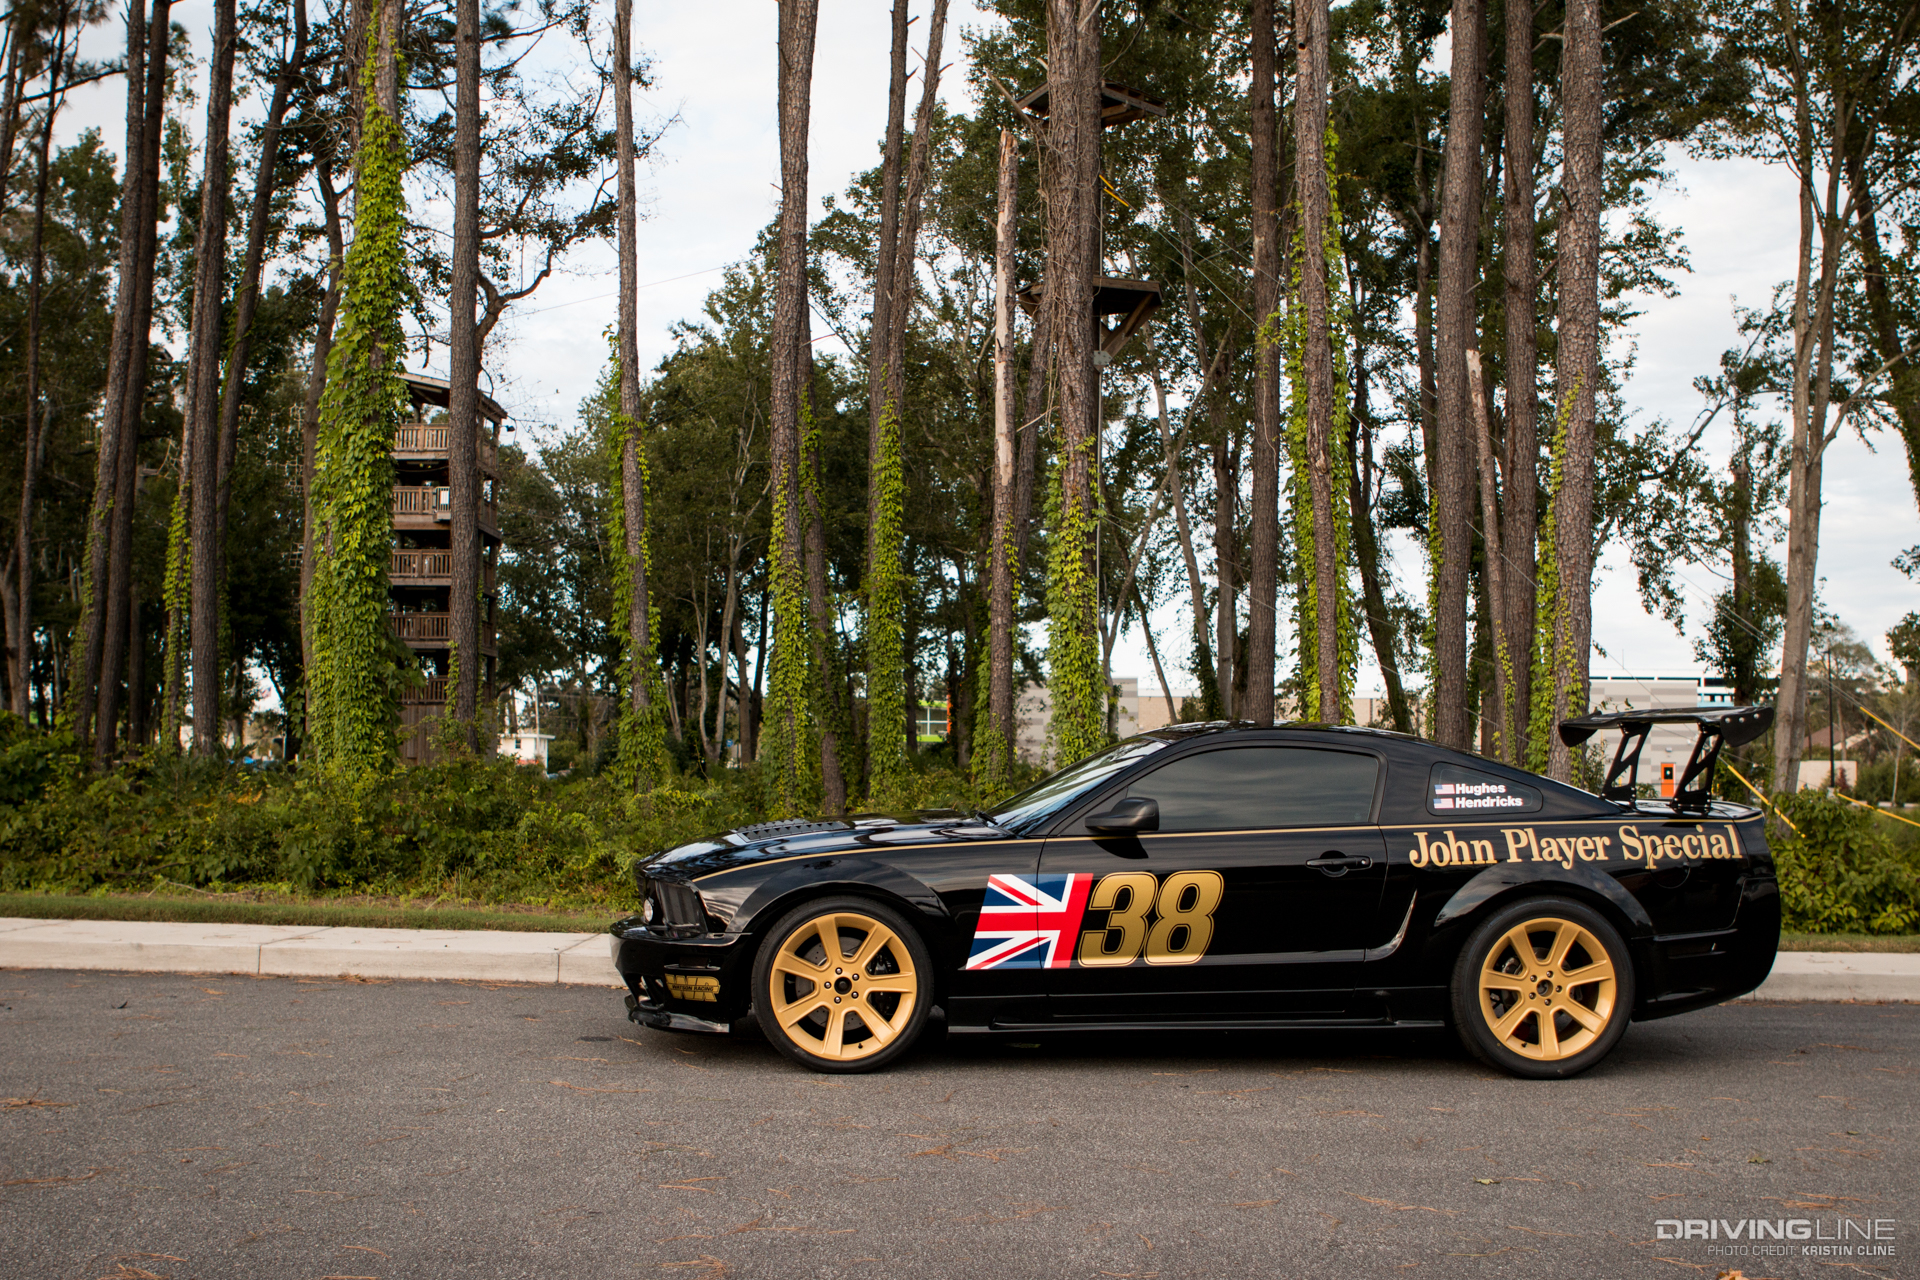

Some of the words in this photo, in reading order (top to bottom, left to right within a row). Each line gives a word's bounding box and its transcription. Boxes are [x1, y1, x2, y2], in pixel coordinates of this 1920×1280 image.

[1455, 783, 1506, 797] Hughes
[1455, 796, 1523, 809] Hendricks
[1408, 830, 1498, 868] John
[1500, 827, 1611, 870] Player
[1618, 824, 1743, 870] Special
[1078, 870, 1224, 967] 38
